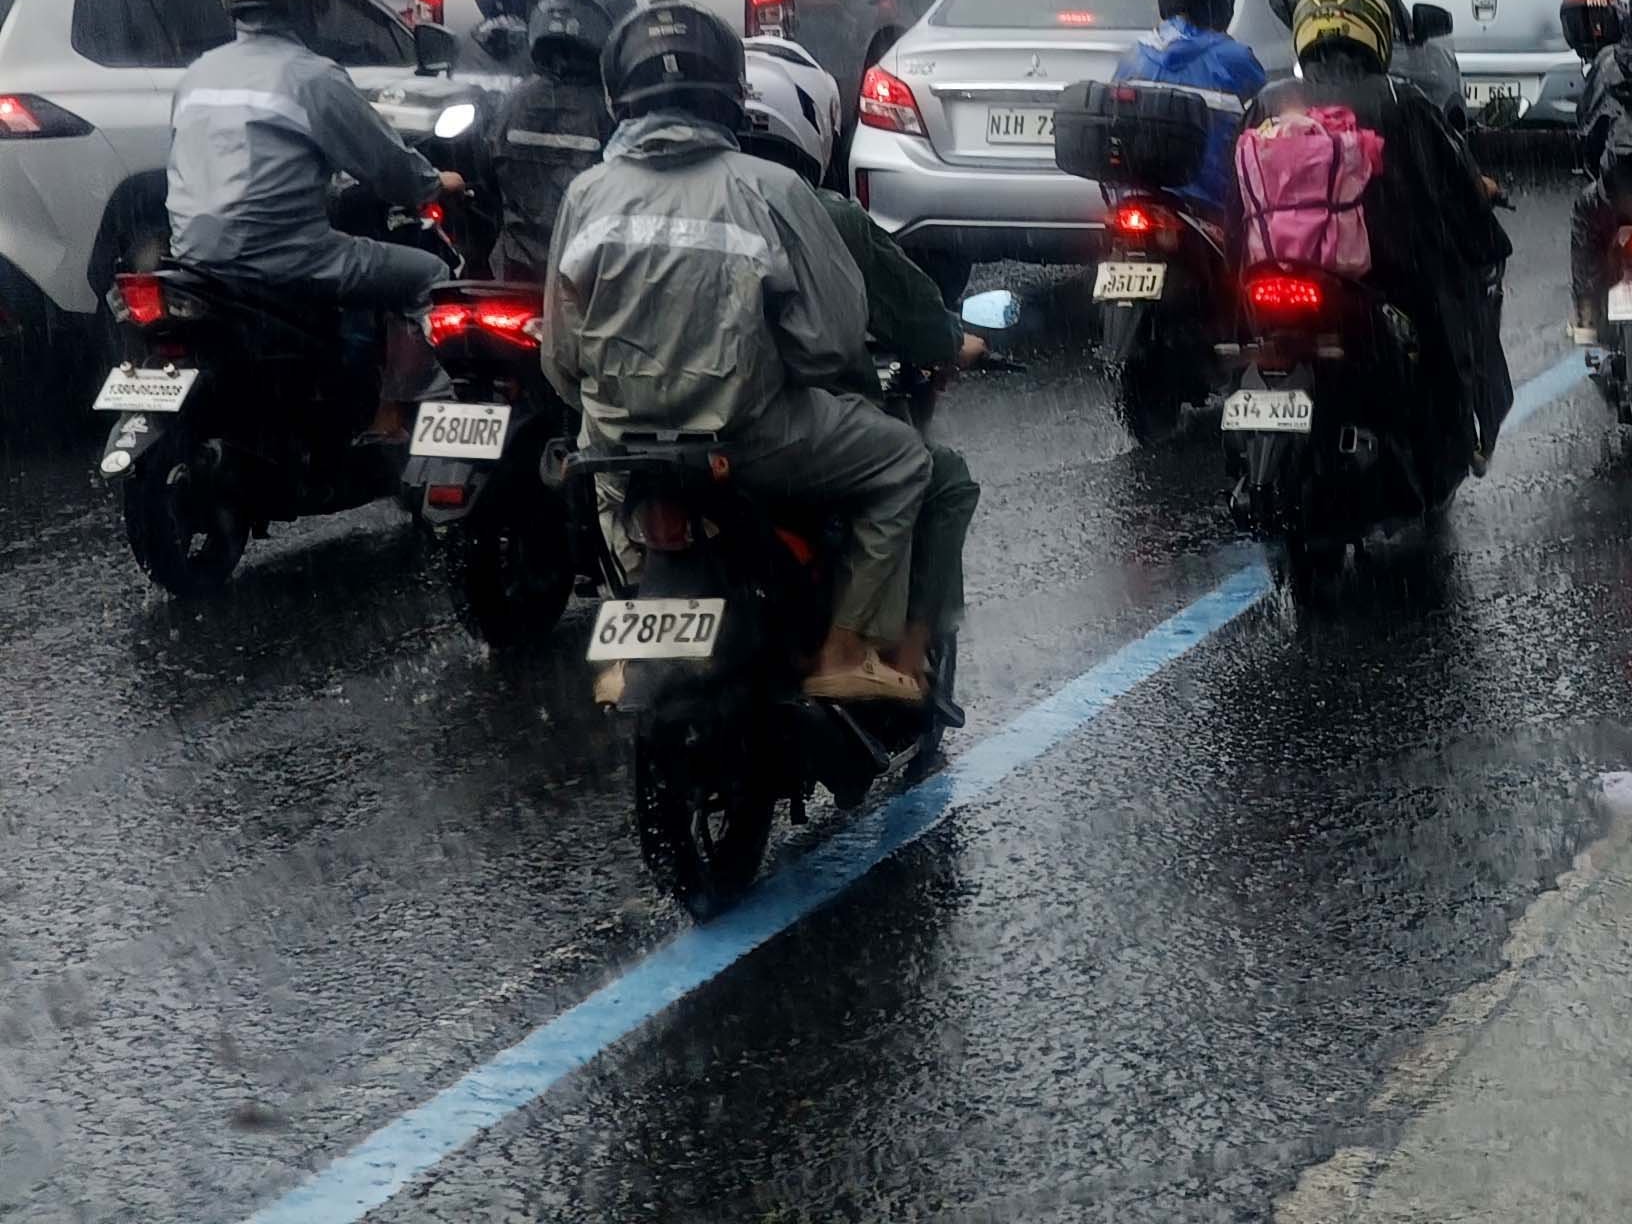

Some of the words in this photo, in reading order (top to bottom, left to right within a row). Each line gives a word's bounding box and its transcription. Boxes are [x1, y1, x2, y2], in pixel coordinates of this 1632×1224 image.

[990, 114, 1026, 136] NIH
[1269, 402, 1309, 419] XND
[417, 415, 503, 447] 768URR
[599, 612, 716, 645] 678PZD
